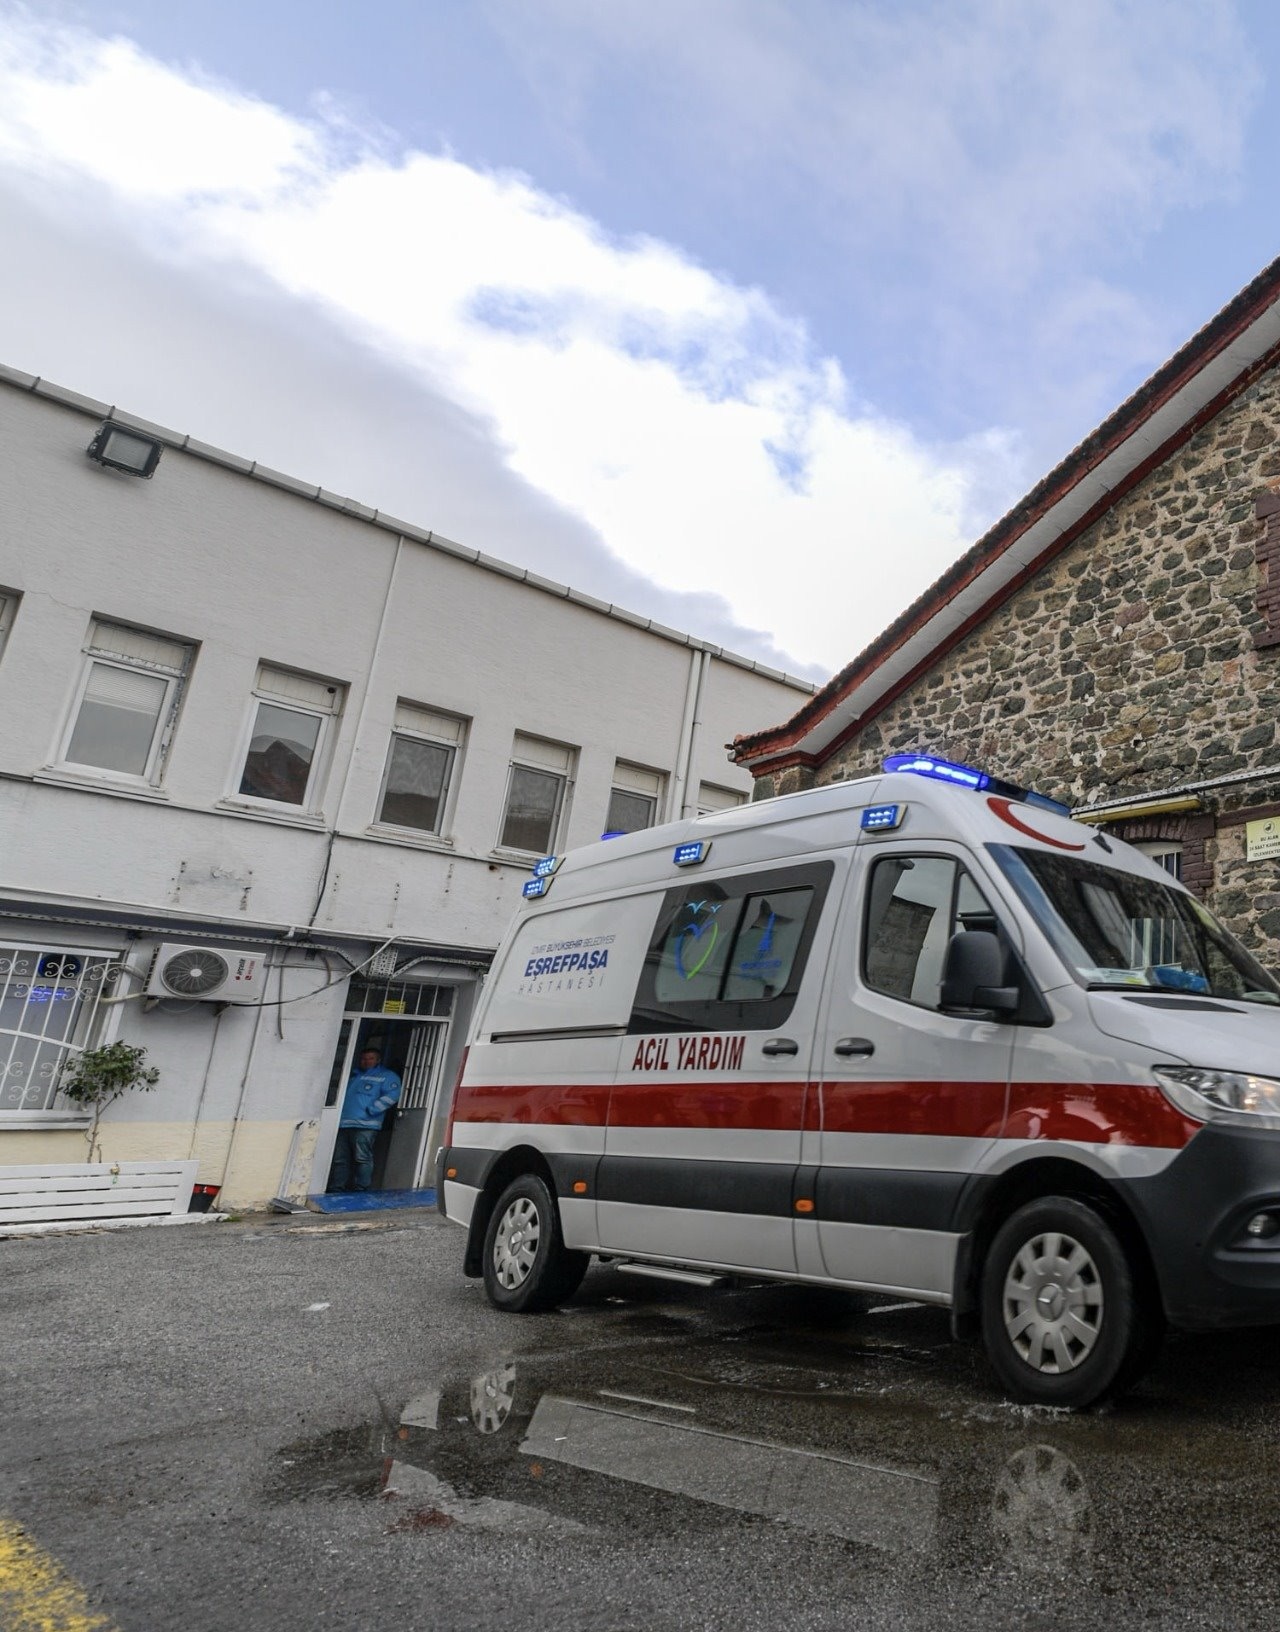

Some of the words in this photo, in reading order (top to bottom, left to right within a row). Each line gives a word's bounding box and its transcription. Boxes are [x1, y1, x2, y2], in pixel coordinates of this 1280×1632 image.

[524, 949, 609, 981] EŞREFPAŞA
[631, 1037, 669, 1071] ACİL
[677, 1035, 746, 1071] YARDIM
